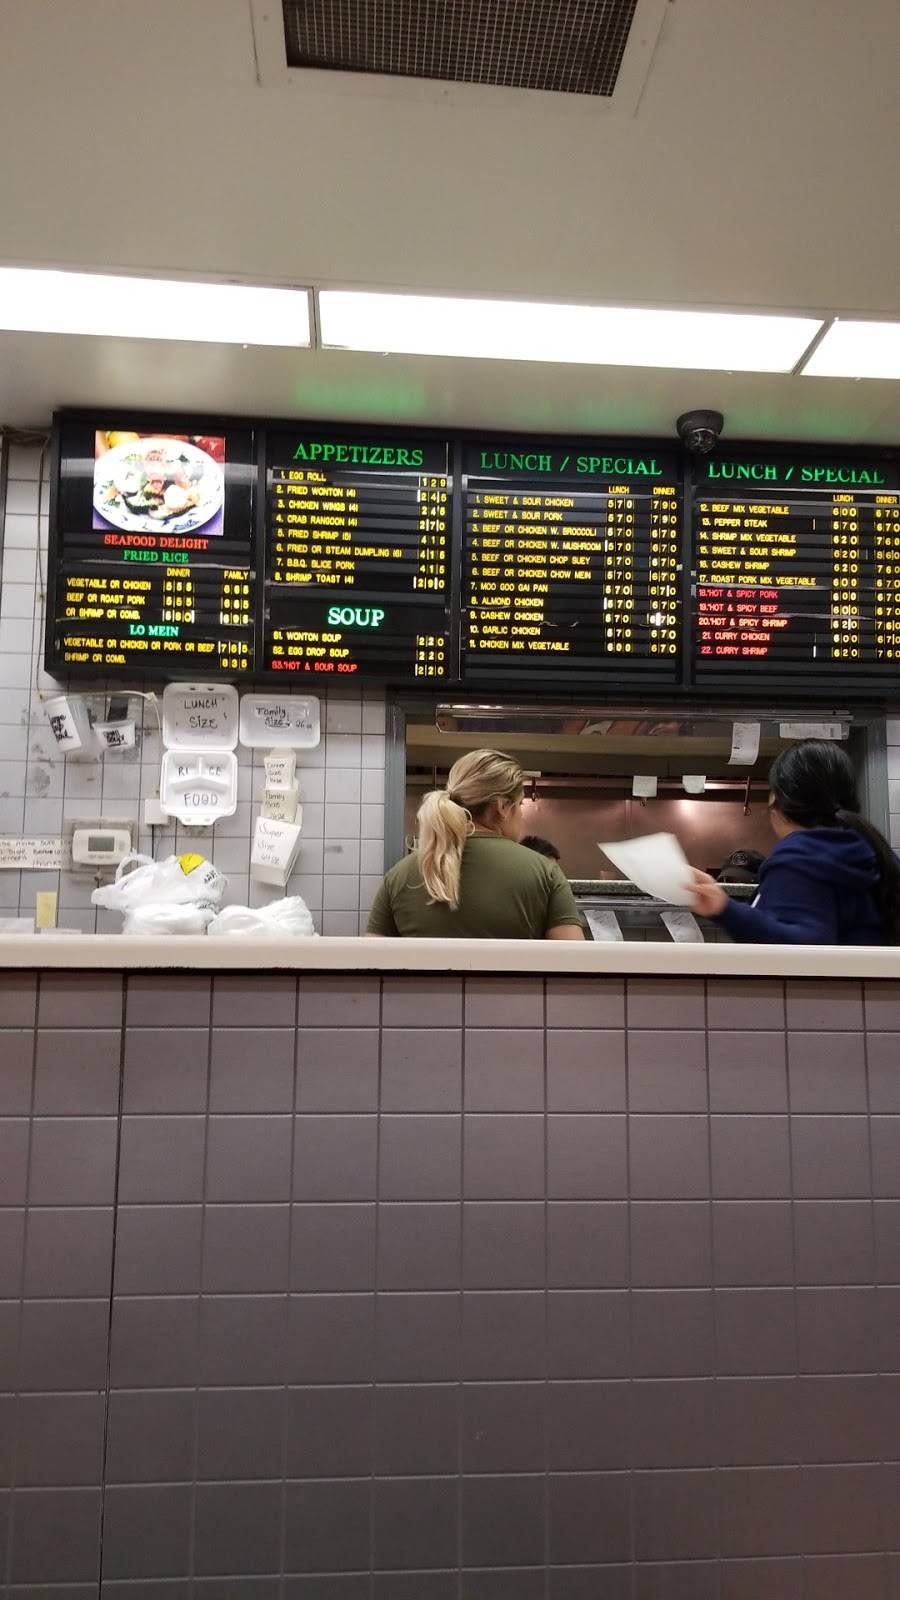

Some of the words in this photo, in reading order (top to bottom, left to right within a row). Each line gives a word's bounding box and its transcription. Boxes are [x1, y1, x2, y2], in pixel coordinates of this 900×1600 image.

[293, 443, 423, 466] APPETIZERS
[480, 452, 551, 471] LUNCH
[560, 456, 569, 471] /
[577, 457, 663, 475] SPECIAL
[289, 471, 303, 481] EGG
[307, 472, 326, 481] ROLL
[708, 462, 777, 480] LUNCH
[785, 466, 794, 480] /
[801, 466, 885, 484] SPECIAL
[287, 486, 308, 495] FRIED
[312, 488, 343, 497] WONTON
[608, 486, 629, 494] LUNCH
[653, 487, 675, 495] DINNER
[484, 496, 509, 505] SWEET
[513, 496, 518, 505] &
[522, 497, 541, 506] SOUR
[545, 498, 574, 507] CHICKEN
[833, 494, 853, 502] LUNCH
[876, 496, 897, 504] DINNER
[289, 501, 319, 510] CHICKEN
[323, 502, 345, 511] WINGS
[712, 504, 729, 512] BEEF
[733, 505, 745, 513] MIX
[749, 506, 790, 514] VEGETABLE
[287, 515, 307, 524] CRAB
[483, 510, 509, 519] SWEET
[512, 511, 518, 519] &
[522, 511, 540, 520] SOUR
[544, 512, 563, 521] PORK
[714, 518, 740, 527] PEPPER
[744, 519, 767, 528] STEAK
[288, 529, 308, 538] FRIED
[312, 531, 338, 540] SHRIMP
[482, 524, 500, 533] BEEF
[504, 525, 514, 534] OR
[518, 526, 547, 535] CHICKEN
[563, 527, 596, 536] BROCCOLI
[104, 534, 156, 547] SEAFOOD
[160, 537, 208, 549] DELIGHT
[712, 532, 737, 541] SHRIMP
[740, 533, 752, 541] MIX
[755, 534, 797, 543] VEGETABLE
[483, 539, 500, 548] BEEF
[504, 540, 514, 548] OR
[518, 540, 547, 549] CHICKEN
[563, 541, 601, 551] MUSHROOM
[287, 544, 308, 553] FRIED
[312, 545, 321, 553] OR
[326, 546, 351, 555] STEAM
[355, 547, 389, 557] DUMPLING
[712, 547, 736, 555] SWEET
[740, 547, 746, 555] &
[750, 547, 768, 556] SOUR
[771, 548, 796, 557] SHRIMP
[123, 550, 158, 562] FRIED
[162, 552, 189, 563] RICE
[481, 553, 499, 562] BEEF
[504, 554, 513, 563] OR
[517, 554, 546, 564] CHICKEN
[550, 556, 568, 565] CHOP
[572, 556, 590, 566] SUEY
[311, 560, 332, 569] SLICE
[336, 561, 355, 570] PORK
[712, 561, 741, 569] CASHEW
[744, 561, 769, 570] SHRIMP
[166, 568, 190, 578] DINNER
[224, 571, 248, 580] FAMILY
[286, 574, 312, 582] SHRIMP
[316, 574, 341, 583] TOAST
[482, 568, 500, 577] BEEF
[504, 569, 514, 578] OR
[518, 569, 546, 578] CHICKEN
[550, 570, 571, 579] CHOW
[574, 571, 591, 579] MEIN
[67, 578, 107, 589] VEGETABLE
[110, 580, 120, 589] OR
[123, 581, 151, 590] CHICKEN
[711, 575, 735, 583] ROAST
[738, 576, 756, 584] PORK
[760, 576, 773, 584] MIX
[776, 577, 816, 586] VEGETABLE
[480, 583, 496, 591] MOO
[500, 583, 514, 592] GOO
[518, 584, 530, 592] GAI
[533, 584, 548, 592] PAN
[67, 593, 84, 602] BEEF
[88, 594, 97, 603] OR
[100, 595, 123, 604] ROAST
[127, 596, 145, 605] PORK
[727, 589, 732, 597] &
[736, 590, 756, 598] SPICY
[760, 590, 778, 599] PORK
[482, 597, 511, 606] ALMOND
[514, 598, 544, 607] CHICKEN
[66, 608, 76, 616] OR
[79, 609, 104, 618] SHRIMP
[107, 610, 117, 619] OR
[728, 604, 733, 612] &
[737, 604, 756, 613] SPICY
[760, 605, 778, 613] BEEF
[328, 607, 385, 626] SOUP
[480, 612, 511, 620] CASHEW
[514, 612, 544, 621] CHICKEN
[730, 618, 735, 626] &
[739, 618, 759, 627] SPICY
[762, 619, 787, 628] SHRIMP
[130, 624, 145, 635] LO
[149, 625, 179, 637] MEIN
[482, 626, 508, 635] GARLIC
[511, 626, 540, 635] CHICKEN
[287, 632, 318, 641] WONTON
[322, 633, 341, 642] SOUP
[715, 632, 737, 641] CURRY
[741, 633, 770, 641] CHICKEN
[64, 637, 104, 648] VEGETABLE
[107, 639, 117, 648] OR
[120, 640, 148, 650] CHICKEN
[151, 641, 160, 650] OR
[164, 642, 181, 651] PORK
[185, 642, 195, 651] OR
[198, 643, 215, 652] BEEF
[480, 640, 509, 649] CHICKEN
[512, 641, 524, 649] MIX
[528, 641, 569, 650] VEGETABLE
[288, 647, 303, 656] EGG
[307, 648, 326, 657] DROP
[329, 649, 349, 658] SOUP
[716, 646, 738, 655] CURRY
[742, 647, 768, 655] SHRIMP
[65, 653, 89, 661] SHRIMP
[92, 653, 102, 662] OR
[304, 663, 310, 671] &
[314, 663, 334, 672] SOUR
[338, 663, 357, 672] SOUP
[184, 699, 218, 709] LUNCH
[184, 793, 218, 806] FOOD
